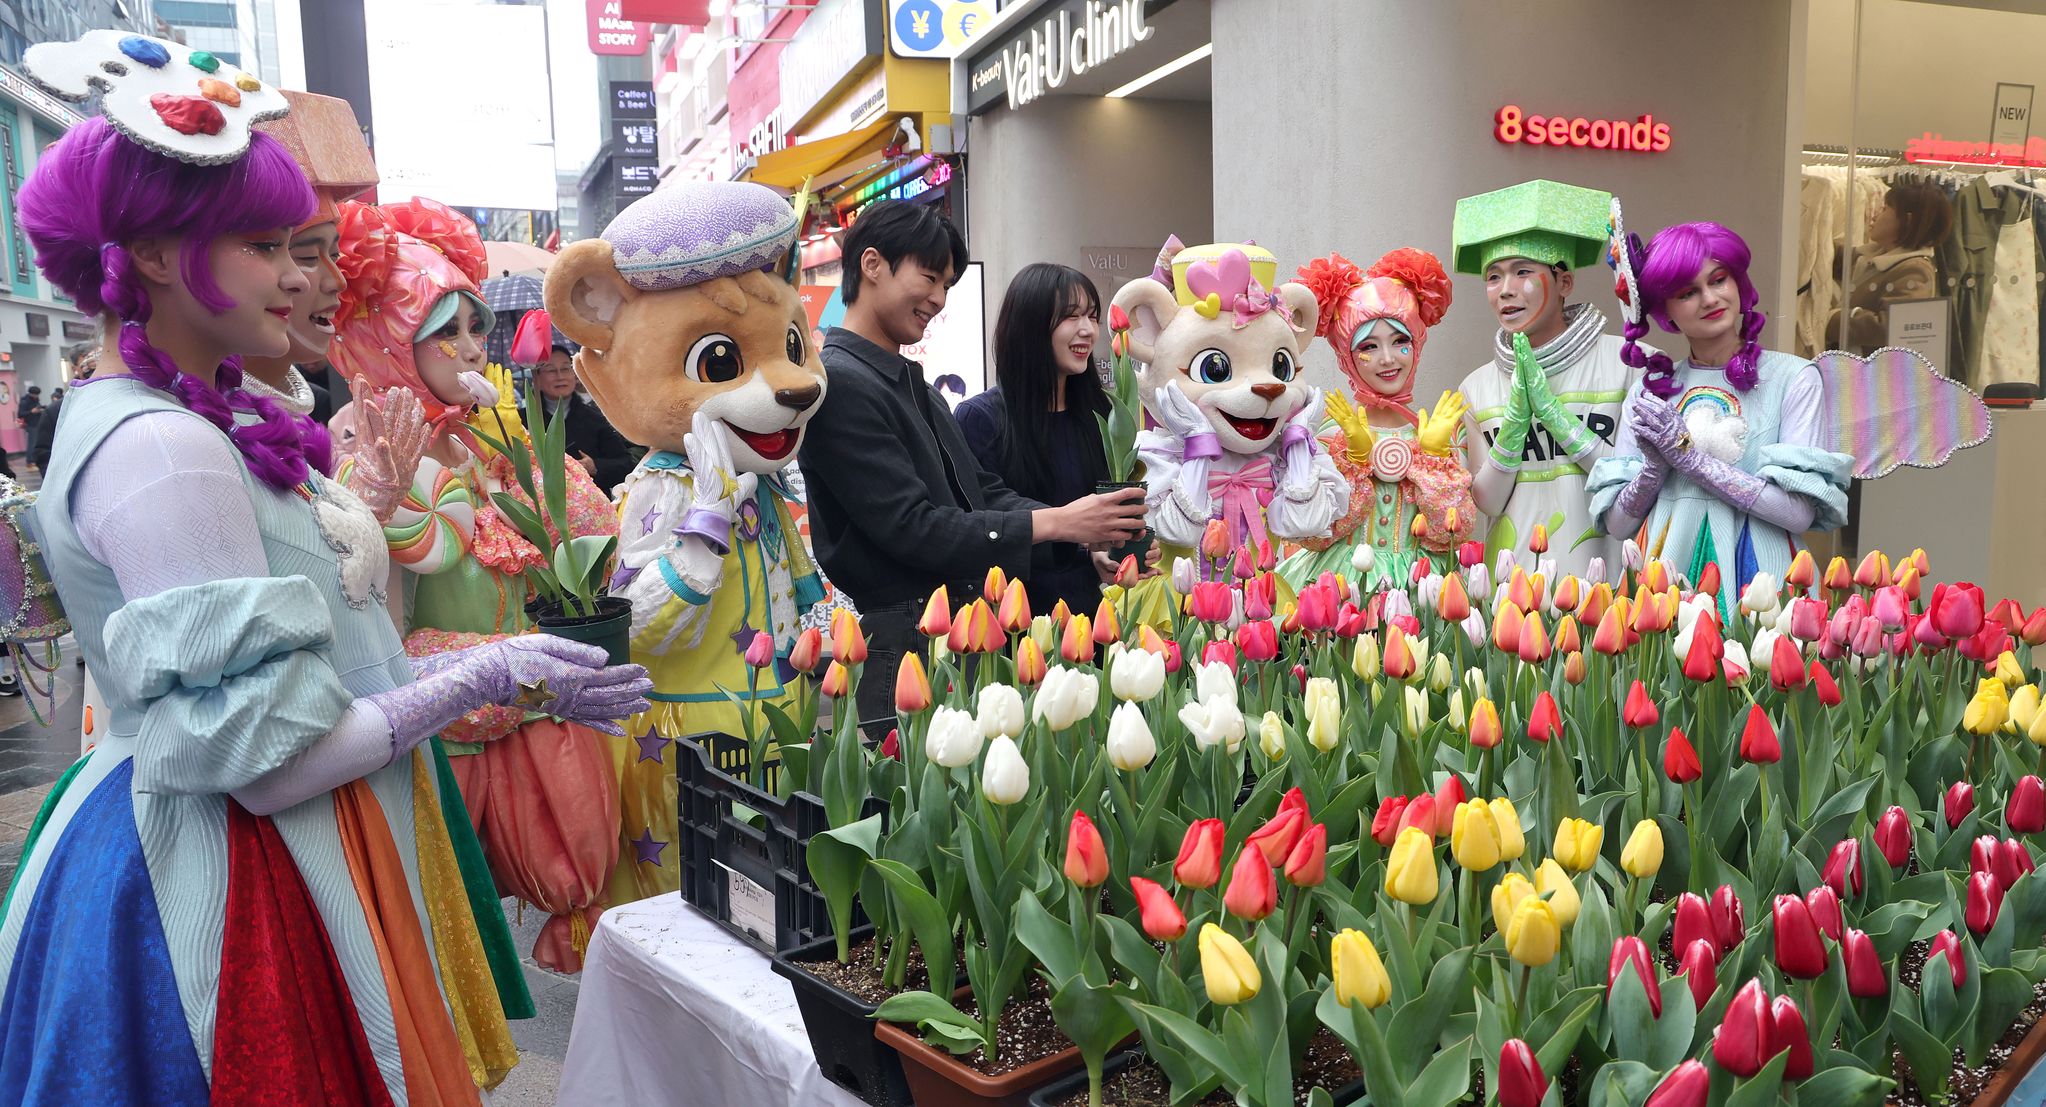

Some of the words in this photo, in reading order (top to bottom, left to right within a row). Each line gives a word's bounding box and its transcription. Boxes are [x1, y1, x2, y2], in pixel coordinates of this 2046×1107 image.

[598, 32, 637, 46] STORY
[972, 60, 1003, 93] K-beauty
[1003, 9, 1069, 111] Val:U
[1070, 0, 1154, 75] clinic
[617, 89, 648, 99] Coffee
[627, 100, 648, 109] Beer
[1999, 106, 2027, 121] NEW
[622, 126, 657, 144] 방탈
[1495, 104, 1523, 143] 8
[1523, 113, 1671, 151] seconds
[1088, 253, 1128, 270] Val:U
